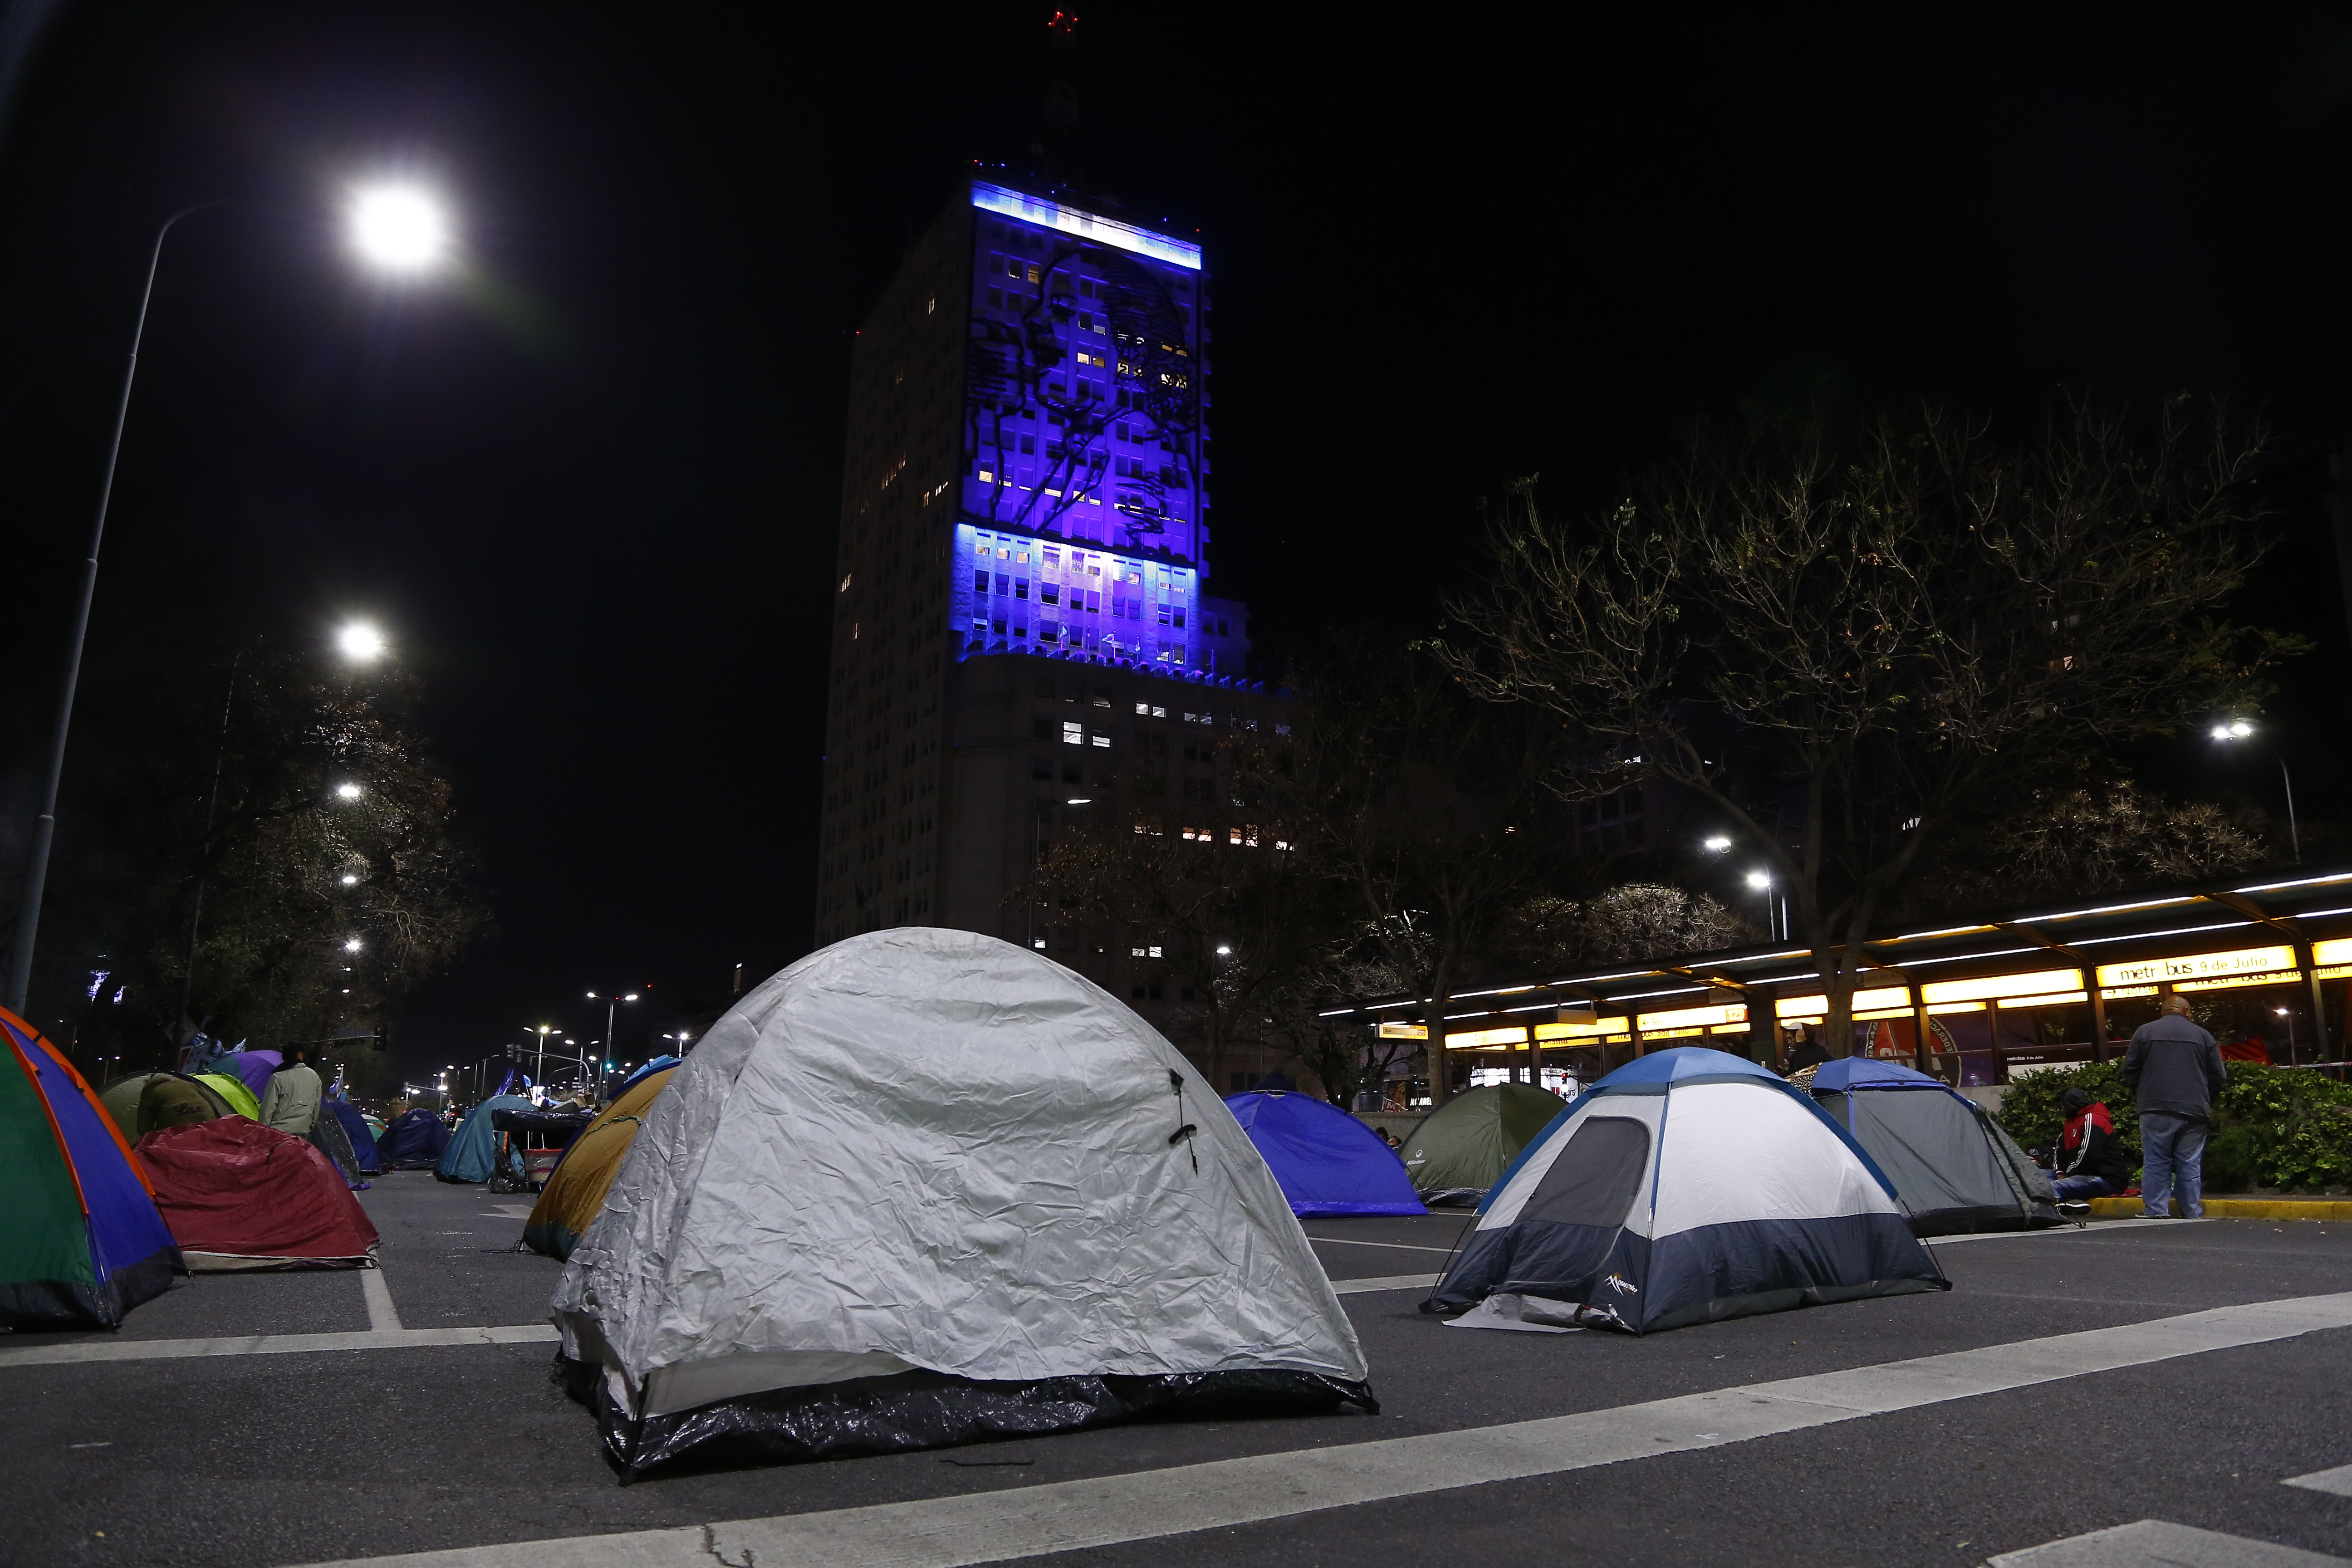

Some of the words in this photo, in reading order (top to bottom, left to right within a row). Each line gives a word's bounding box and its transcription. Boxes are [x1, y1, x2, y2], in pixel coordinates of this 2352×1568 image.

[2200, 961, 2207, 972] 9
[2212, 960, 2228, 971] de
[2233, 956, 2267, 969] Julio
[2121, 986, 2155, 995] Norte
[1651, 1018, 1664, 1026] Sur
[1727, 1009, 1745, 1021] 129
[1474, 1032, 1498, 1043] Alsina
